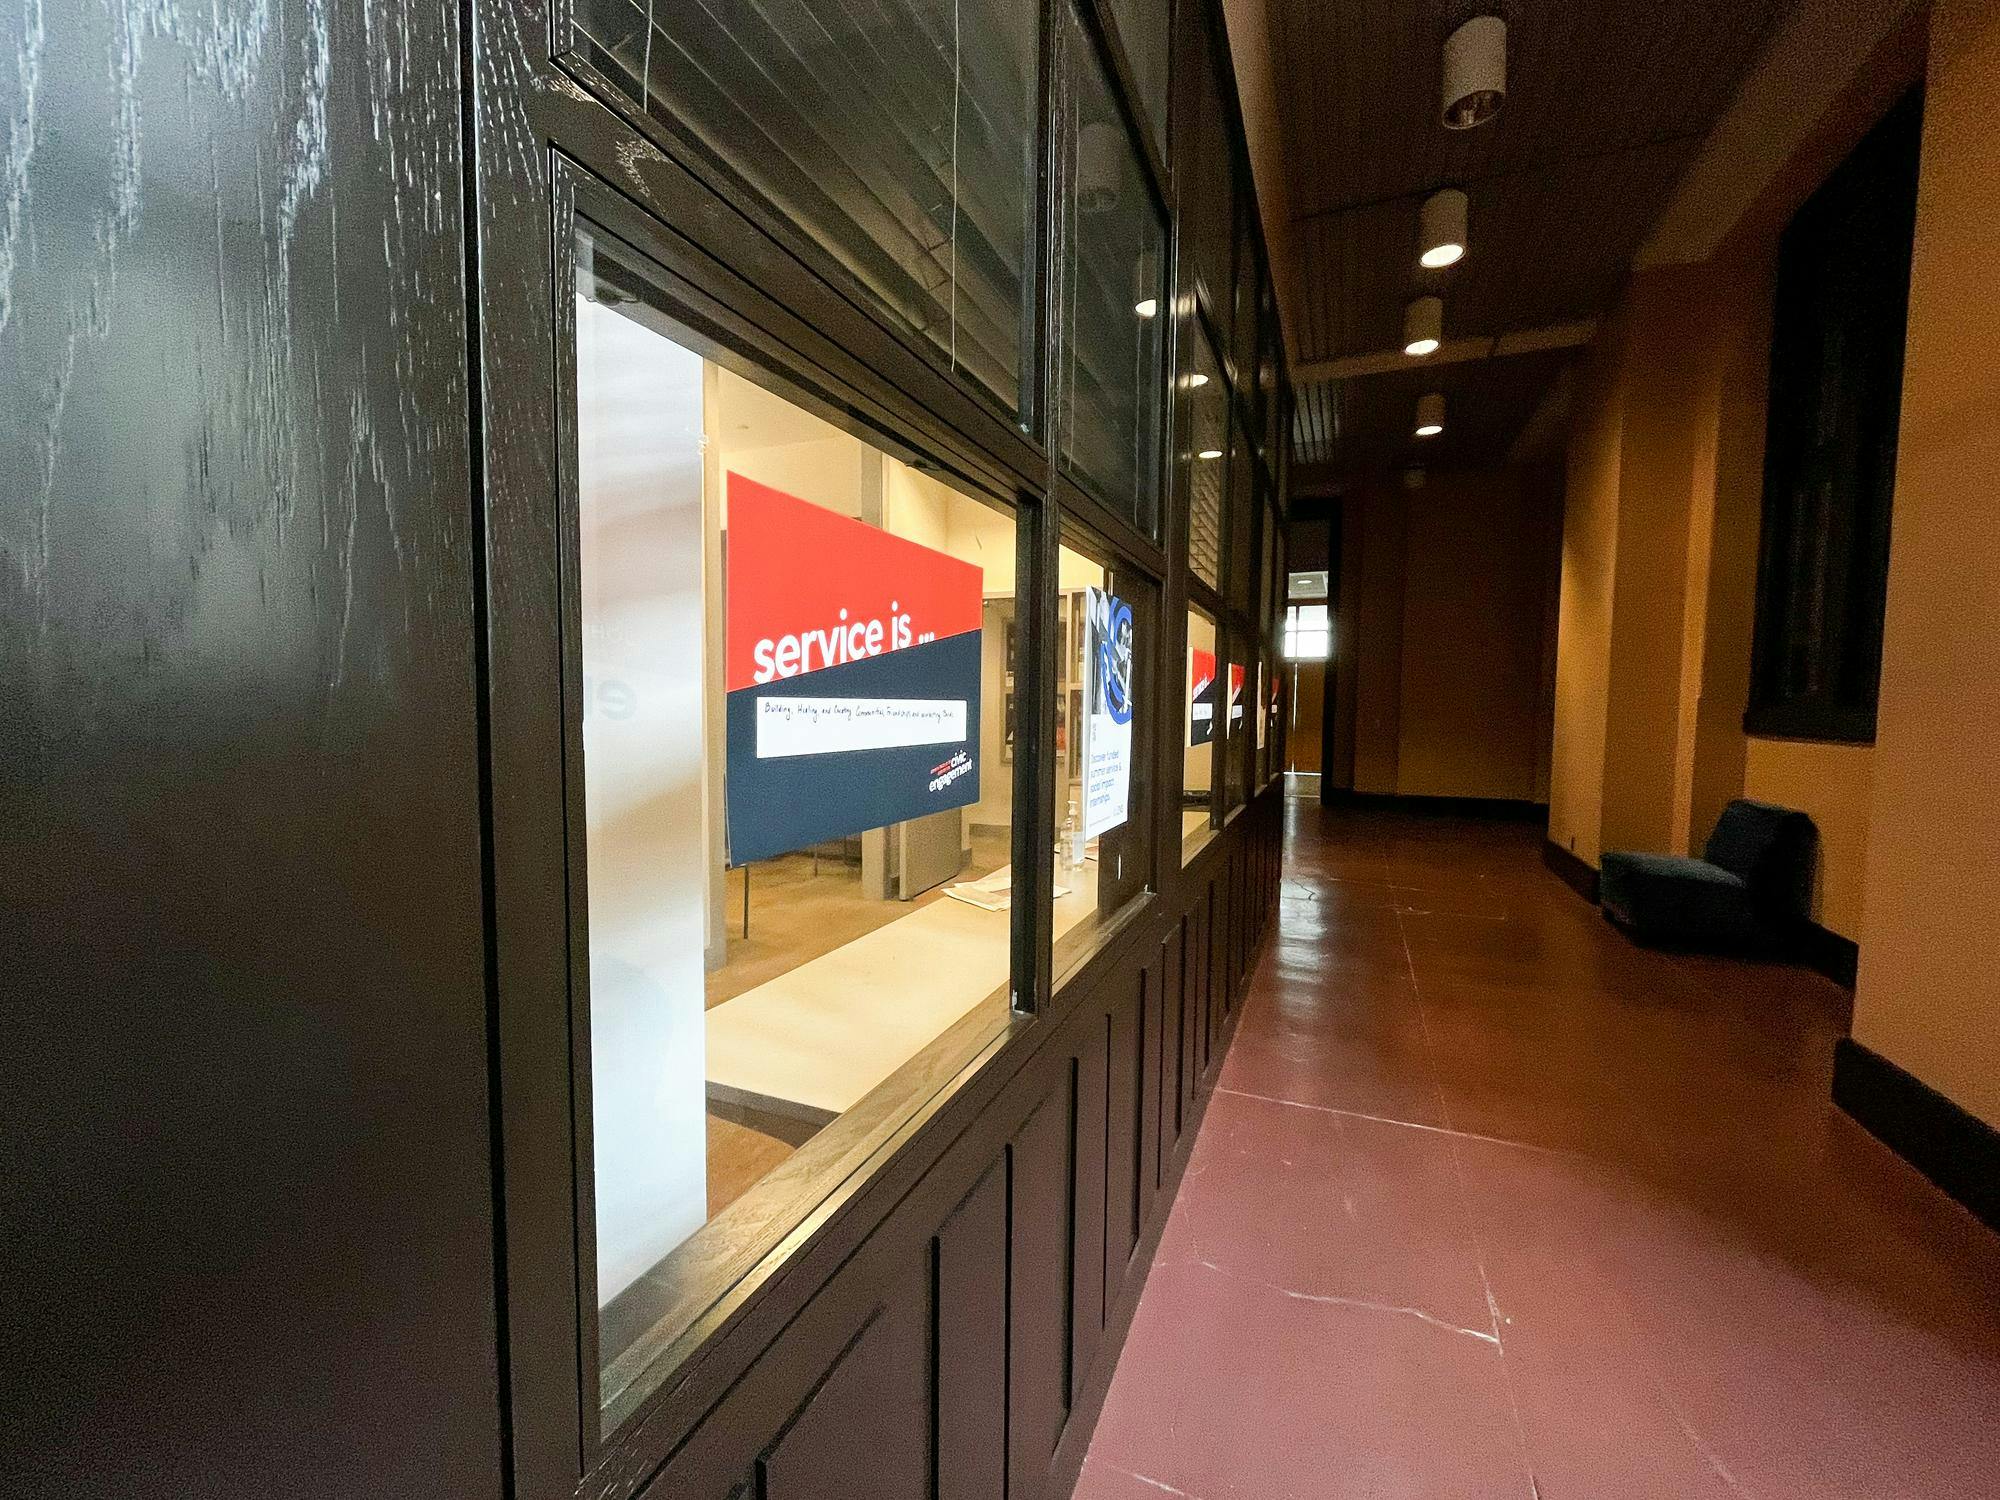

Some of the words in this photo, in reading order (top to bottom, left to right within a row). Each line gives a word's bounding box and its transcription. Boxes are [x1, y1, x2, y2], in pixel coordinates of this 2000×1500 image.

[753, 608, 884, 684] service
[891, 600, 911, 650] is
[929, 758, 973, 792] engagement
[951, 749, 967, 768] civic
